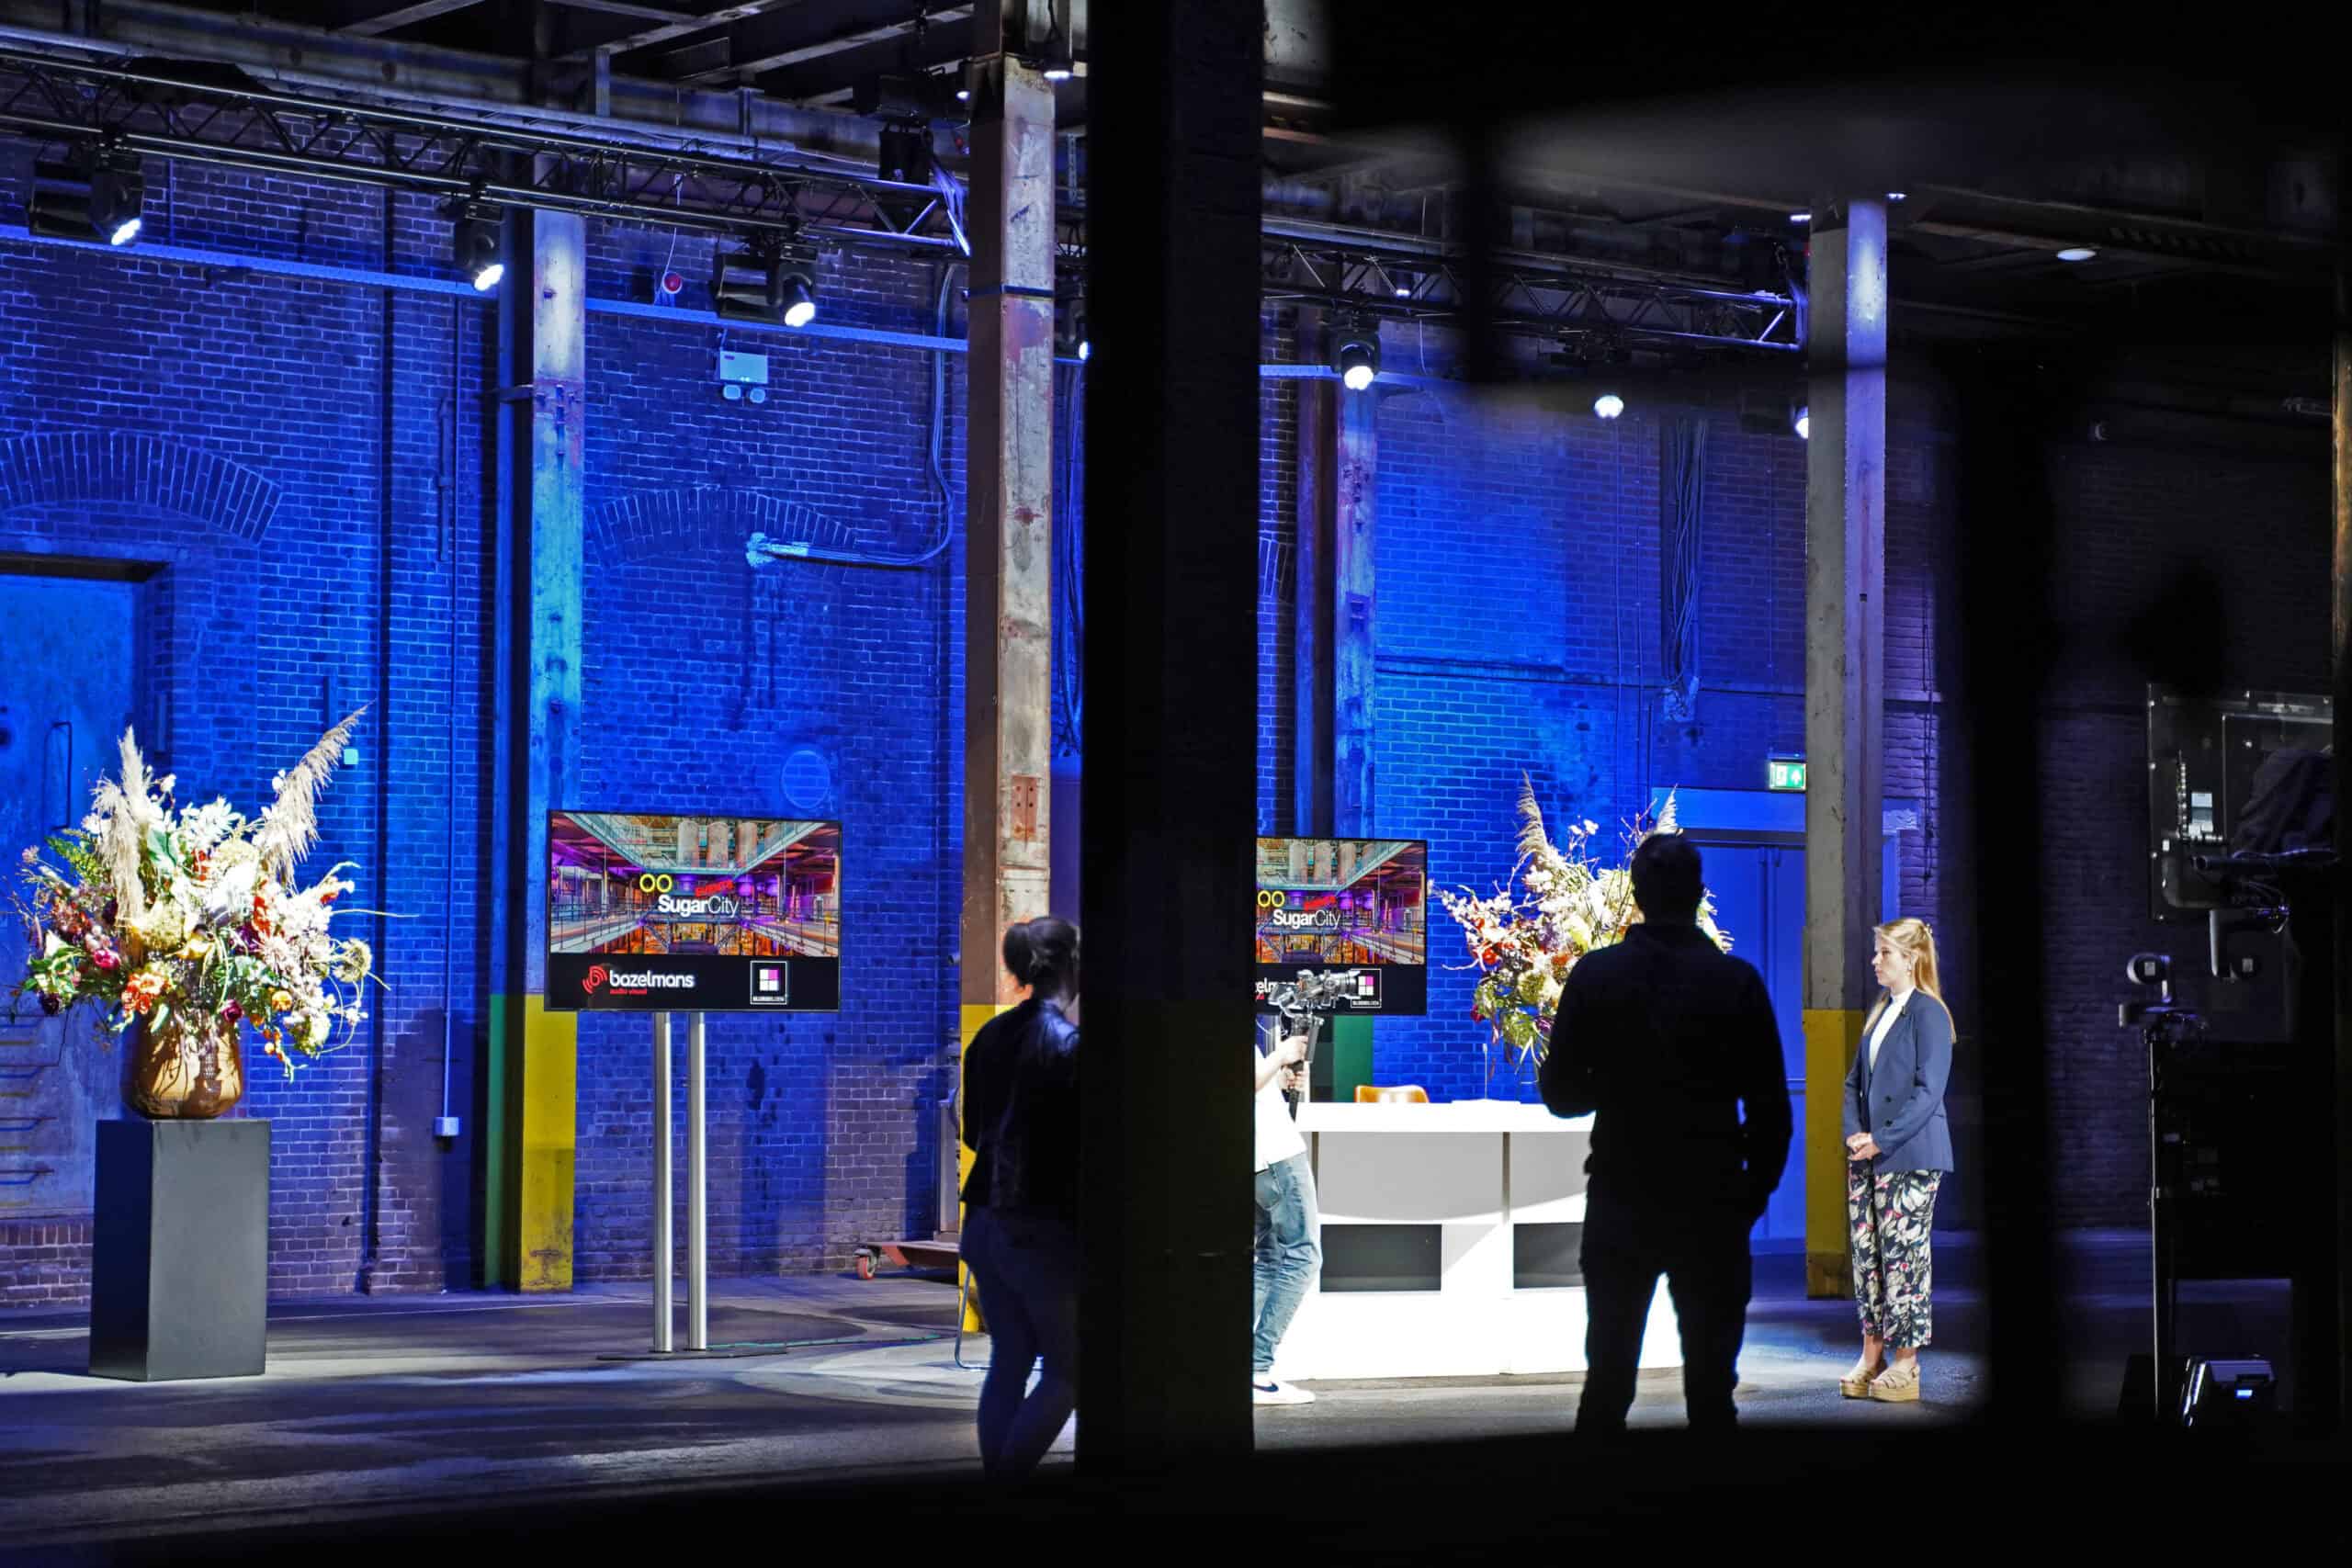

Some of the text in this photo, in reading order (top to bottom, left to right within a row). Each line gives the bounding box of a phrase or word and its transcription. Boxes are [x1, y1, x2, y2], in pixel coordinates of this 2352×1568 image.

[658, 895, 739, 918] SugarCity
[1272, 908, 1340, 930] SugarCity
[609, 969, 695, 987] bazelmans
